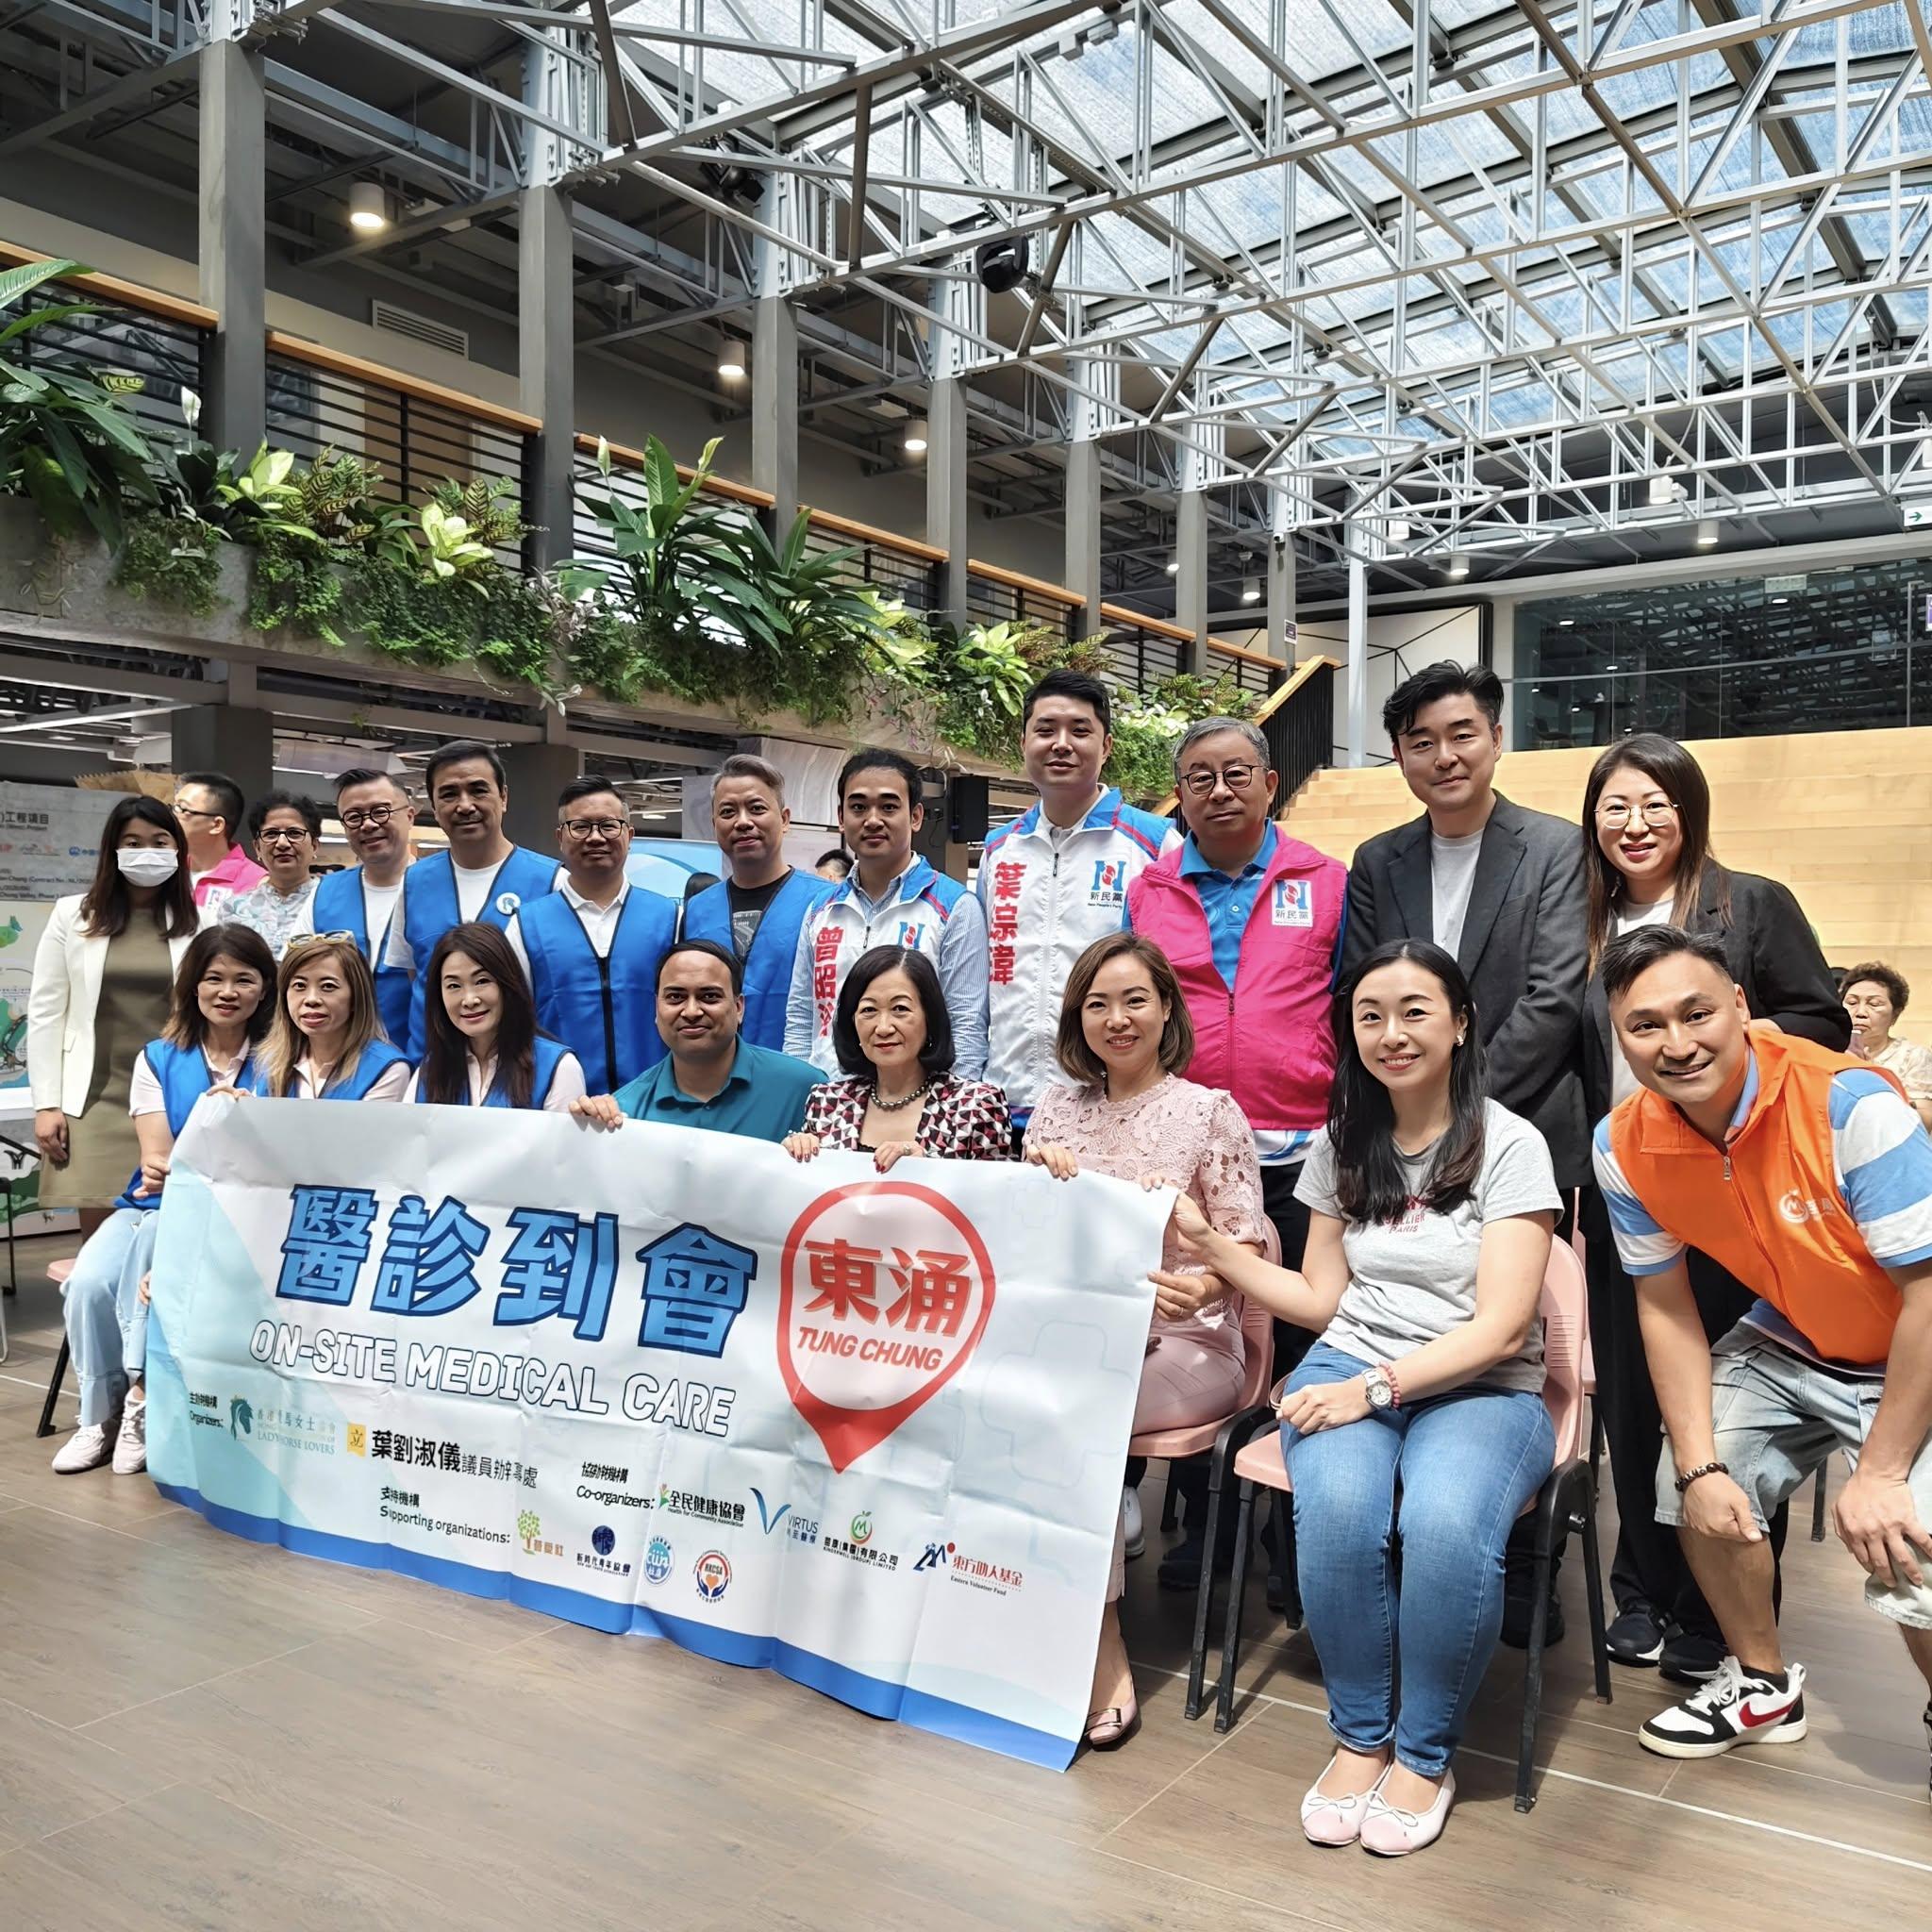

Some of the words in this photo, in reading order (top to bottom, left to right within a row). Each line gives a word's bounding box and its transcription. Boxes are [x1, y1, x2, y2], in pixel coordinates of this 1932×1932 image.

[1389, 1224, 1418, 1234] PARIS
[275, 1184, 758, 1358] 醫診到會
[804, 1238, 973, 1338] 東涌
[797, 1325, 858, 1357] TUNG
[858, 1338, 943, 1372] CHUNG
[249, 1320, 397, 1384] ON-SITE
[405, 1343, 609, 1416] MEDICAL
[622, 1373, 738, 1438] CARE
[189, 1410, 224, 1428] Organizers:
[304, 1439, 336, 1456] LOVERS
[380, 1485, 420, 1508] 支持機構
[576, 1485, 656, 1509] Co-organizers:
[668, 1491, 746, 1522] 全民健康協會
[691, 1511, 717, 1523] Community
[788, 1513, 819, 1535] VIRTUS
[435, 1520, 511, 1544] organizations:
[953, 1555, 1024, 1587] 東方助人基金
[951, 1575, 969, 1586] Eastern
[970, 1580, 993, 1591] Volunteer
[993, 1587, 1007, 1596] Fund
